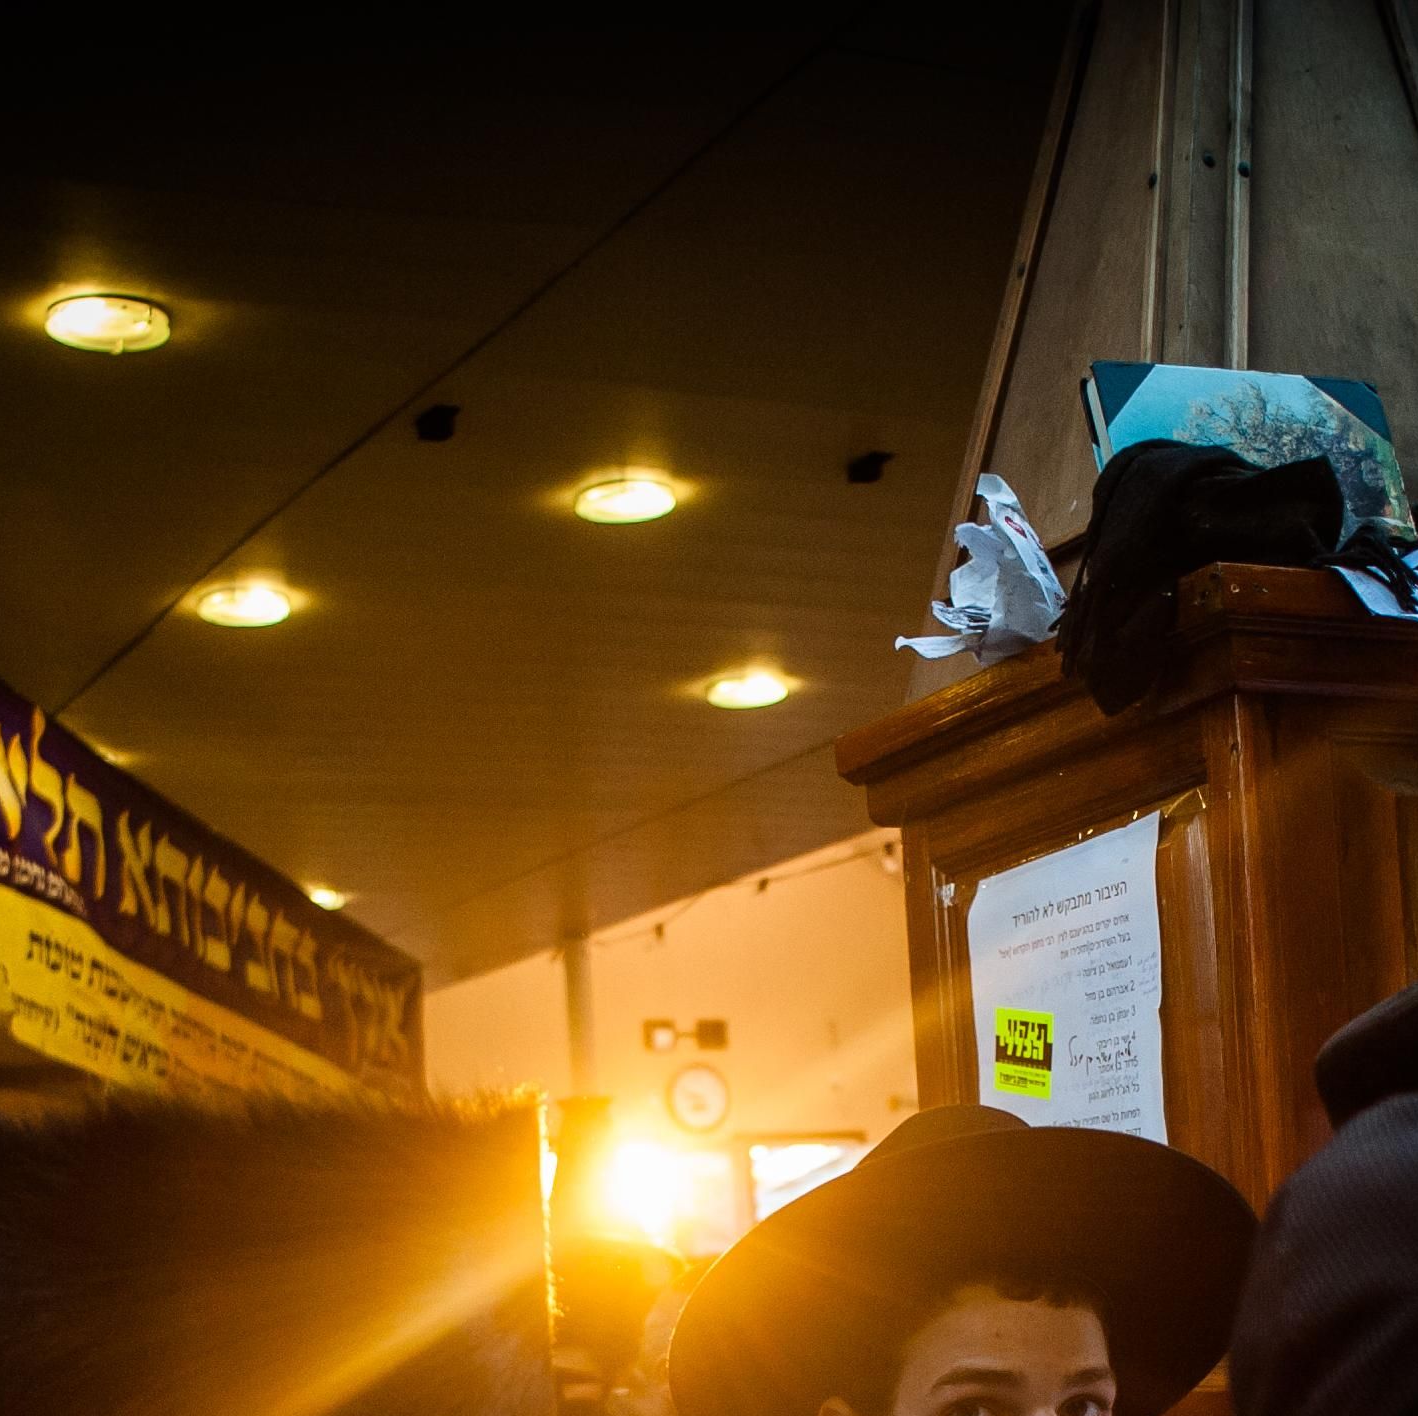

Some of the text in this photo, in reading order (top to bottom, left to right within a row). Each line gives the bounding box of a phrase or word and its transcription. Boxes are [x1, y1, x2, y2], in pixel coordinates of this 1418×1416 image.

[1012, 880, 1128, 929] הציבור מתבקש לא להוריד
